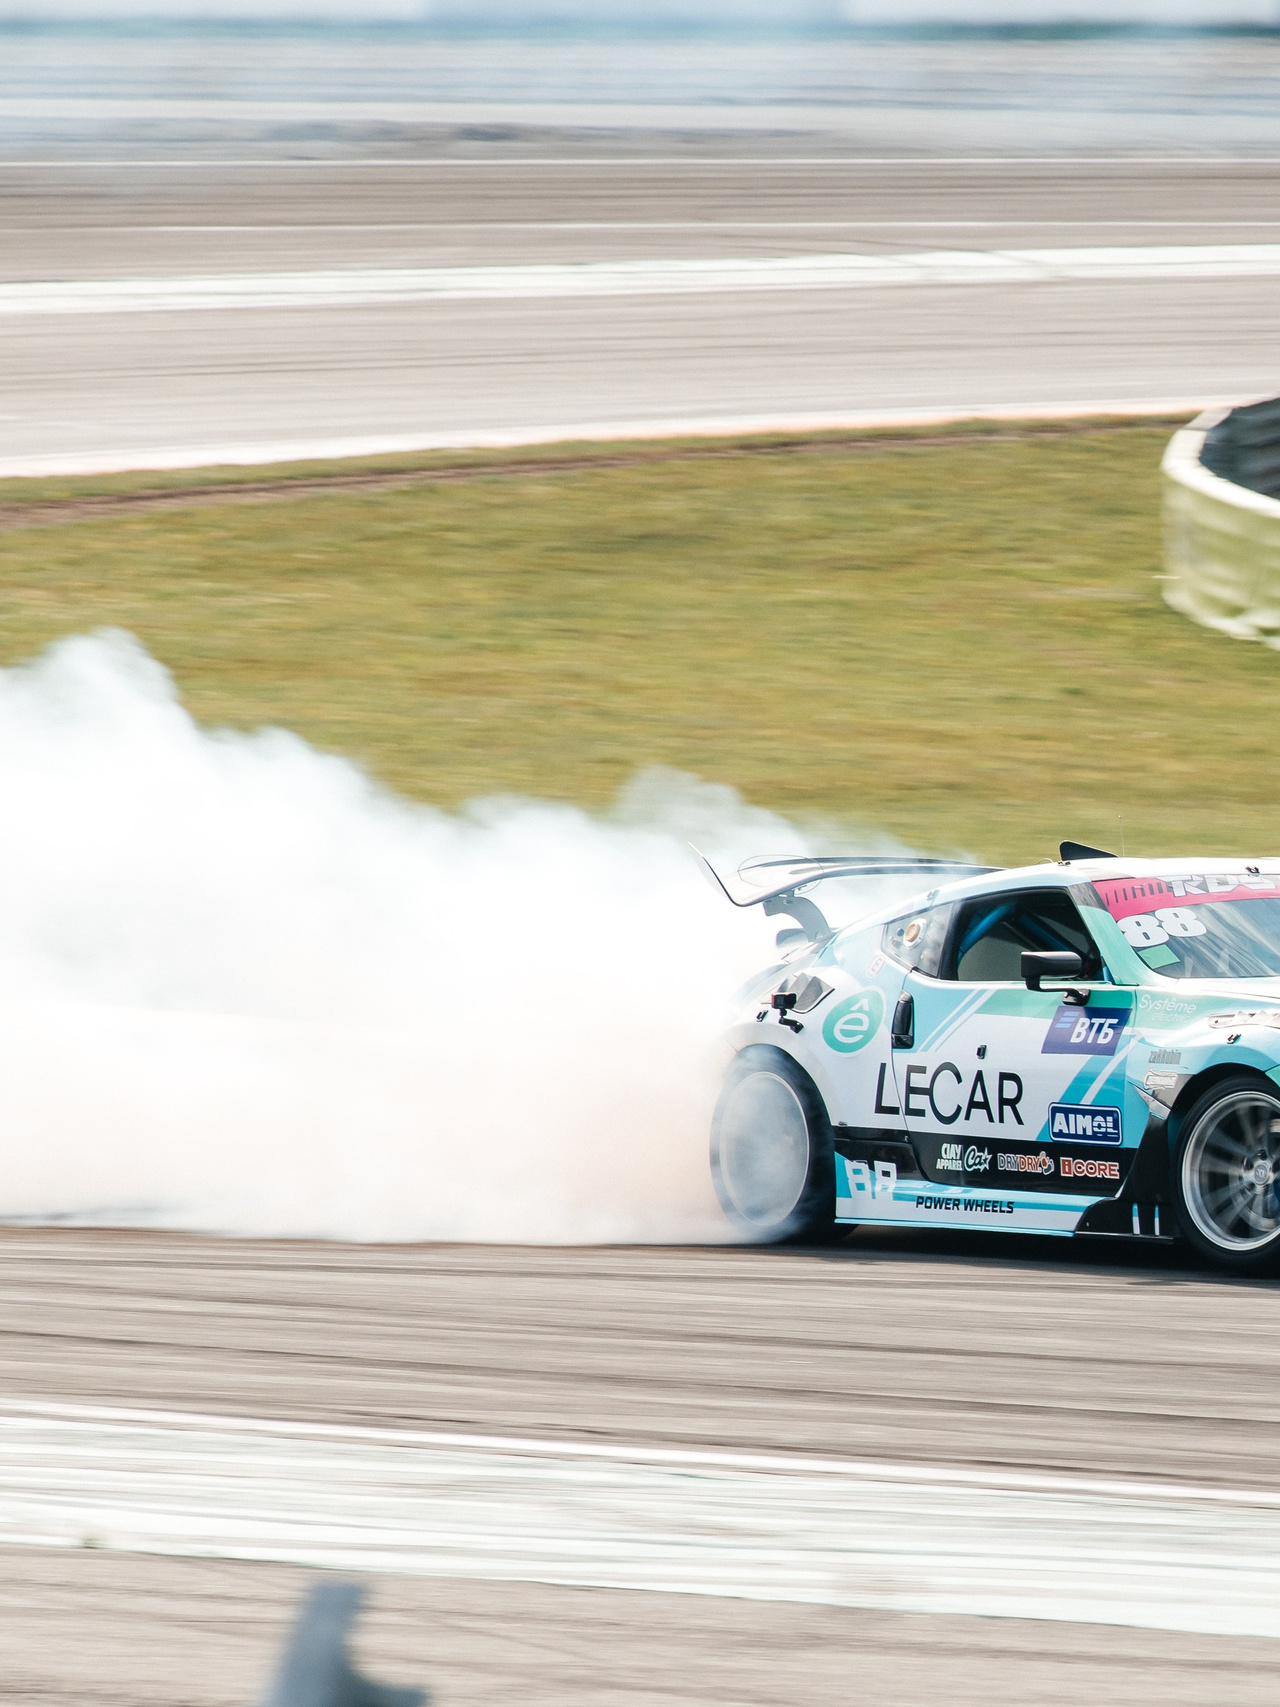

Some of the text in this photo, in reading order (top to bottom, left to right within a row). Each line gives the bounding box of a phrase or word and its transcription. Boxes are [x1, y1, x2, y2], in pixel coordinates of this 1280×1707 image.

[1117, 908, 1207, 948] 88
[1070, 1017, 1119, 1044] ВТБ
[874, 1061, 1025, 1126] LECAR
[1053, 1112, 1119, 1137] AIMOL
[936, 1158, 963, 1171] APPAREL
[941, 1143, 962, 1160] CLAY
[844, 1160, 897, 1200] 88
[915, 1196, 1015, 1214] POWER WHEELS
